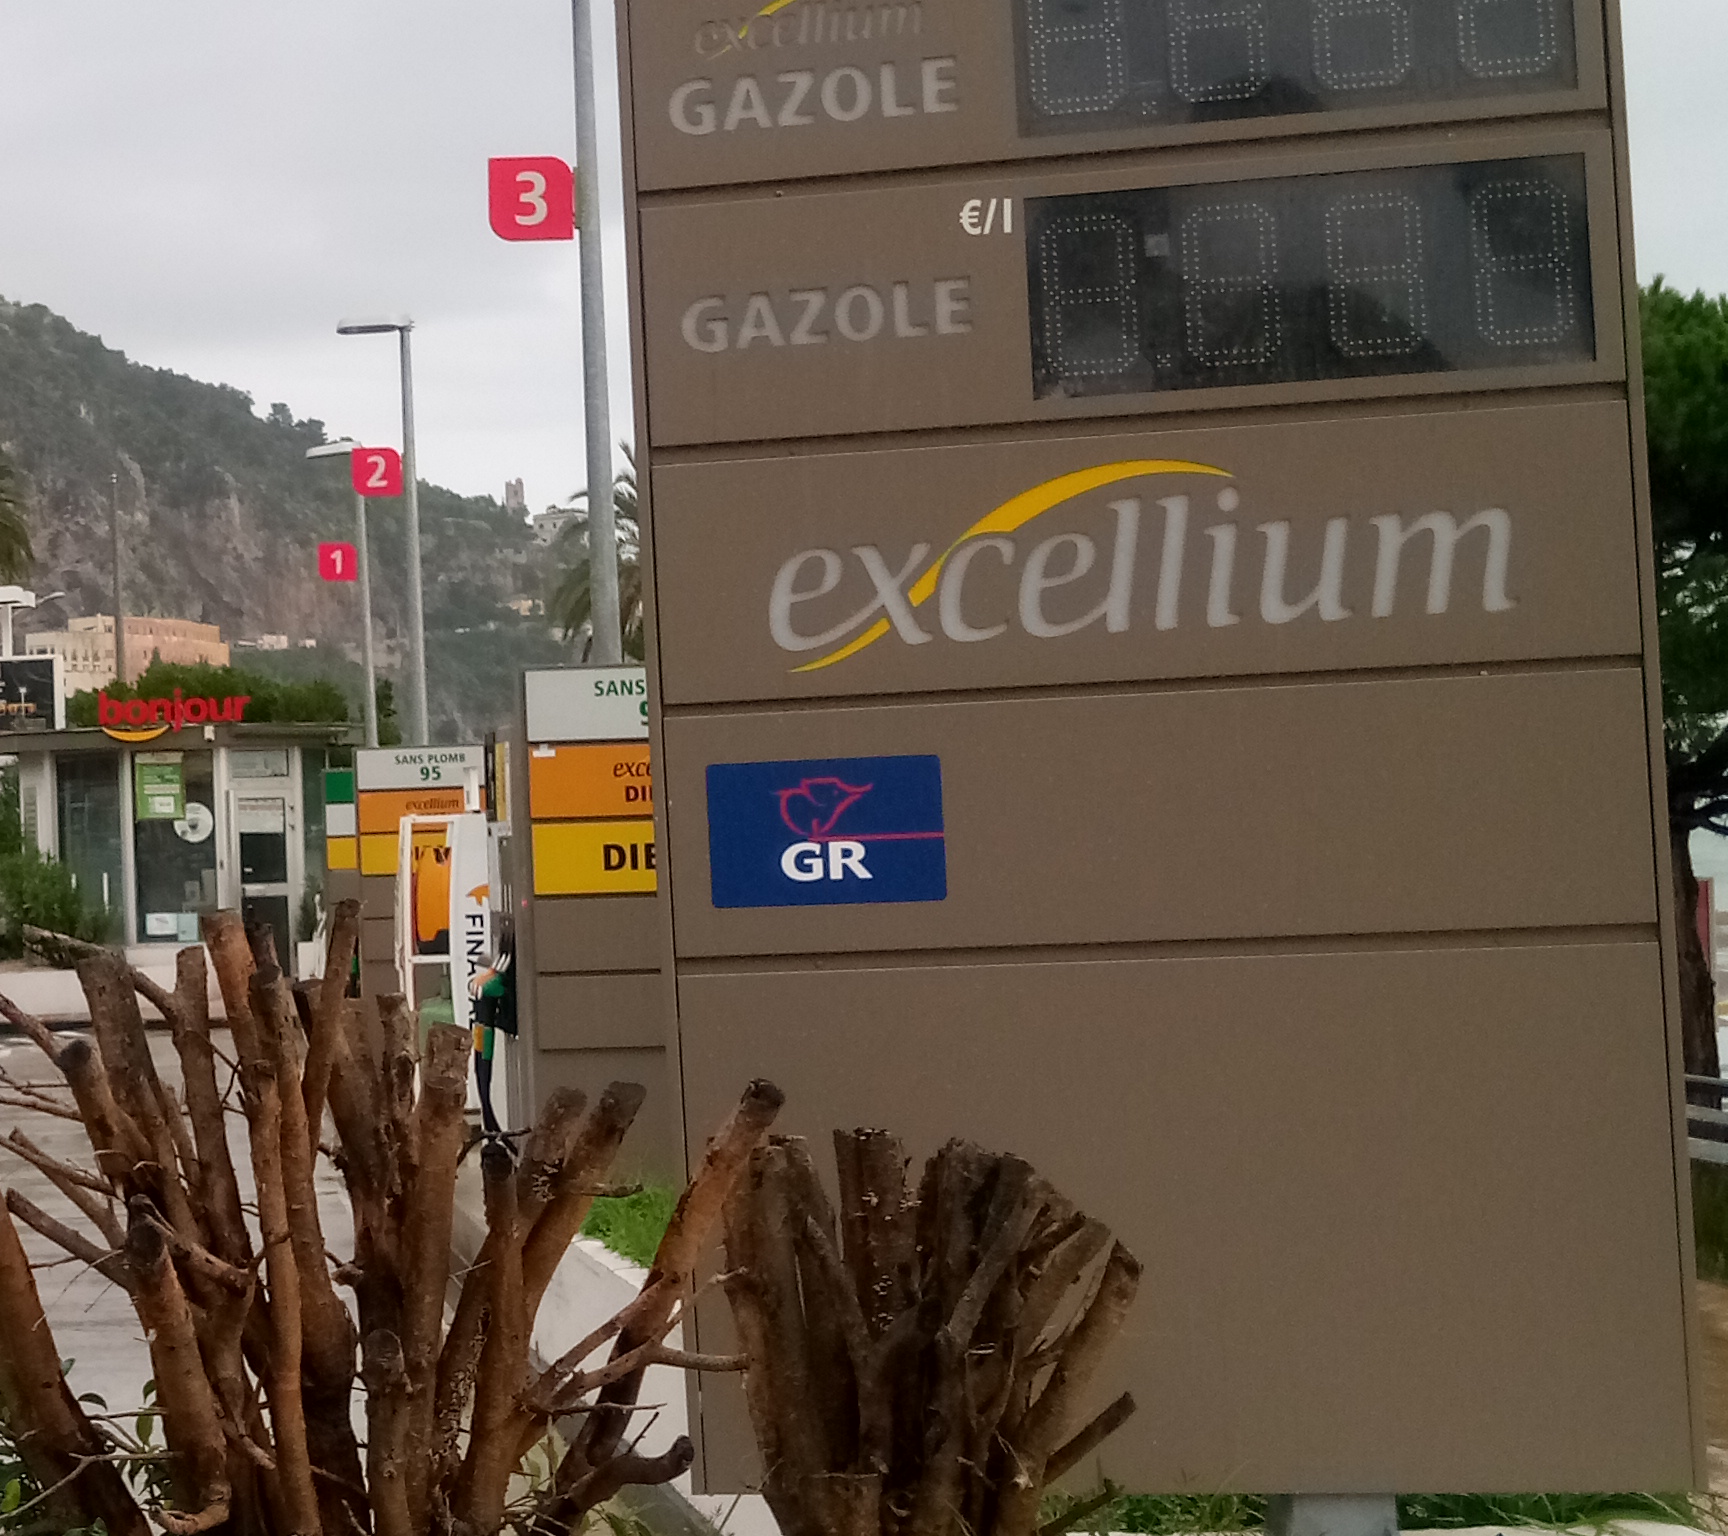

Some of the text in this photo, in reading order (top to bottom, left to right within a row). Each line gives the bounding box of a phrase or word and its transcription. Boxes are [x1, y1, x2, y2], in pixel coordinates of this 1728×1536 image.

[668, 55, 959, 136] GAZOLE
[513, 170, 548, 226] 3
[680, 274, 973, 353] GAZOLE
[365, 454, 387, 489] 2
[328, 548, 344, 575] 1
[768, 484, 1518, 654] excellium
[593, 678, 646, 698] SANS
[97, 687, 252, 734] bonjour
[394, 752, 467, 766] SANS PLOMB
[419, 765, 442, 782] 95
[405, 797, 460, 811] excellium
[780, 840, 873, 884] GR
